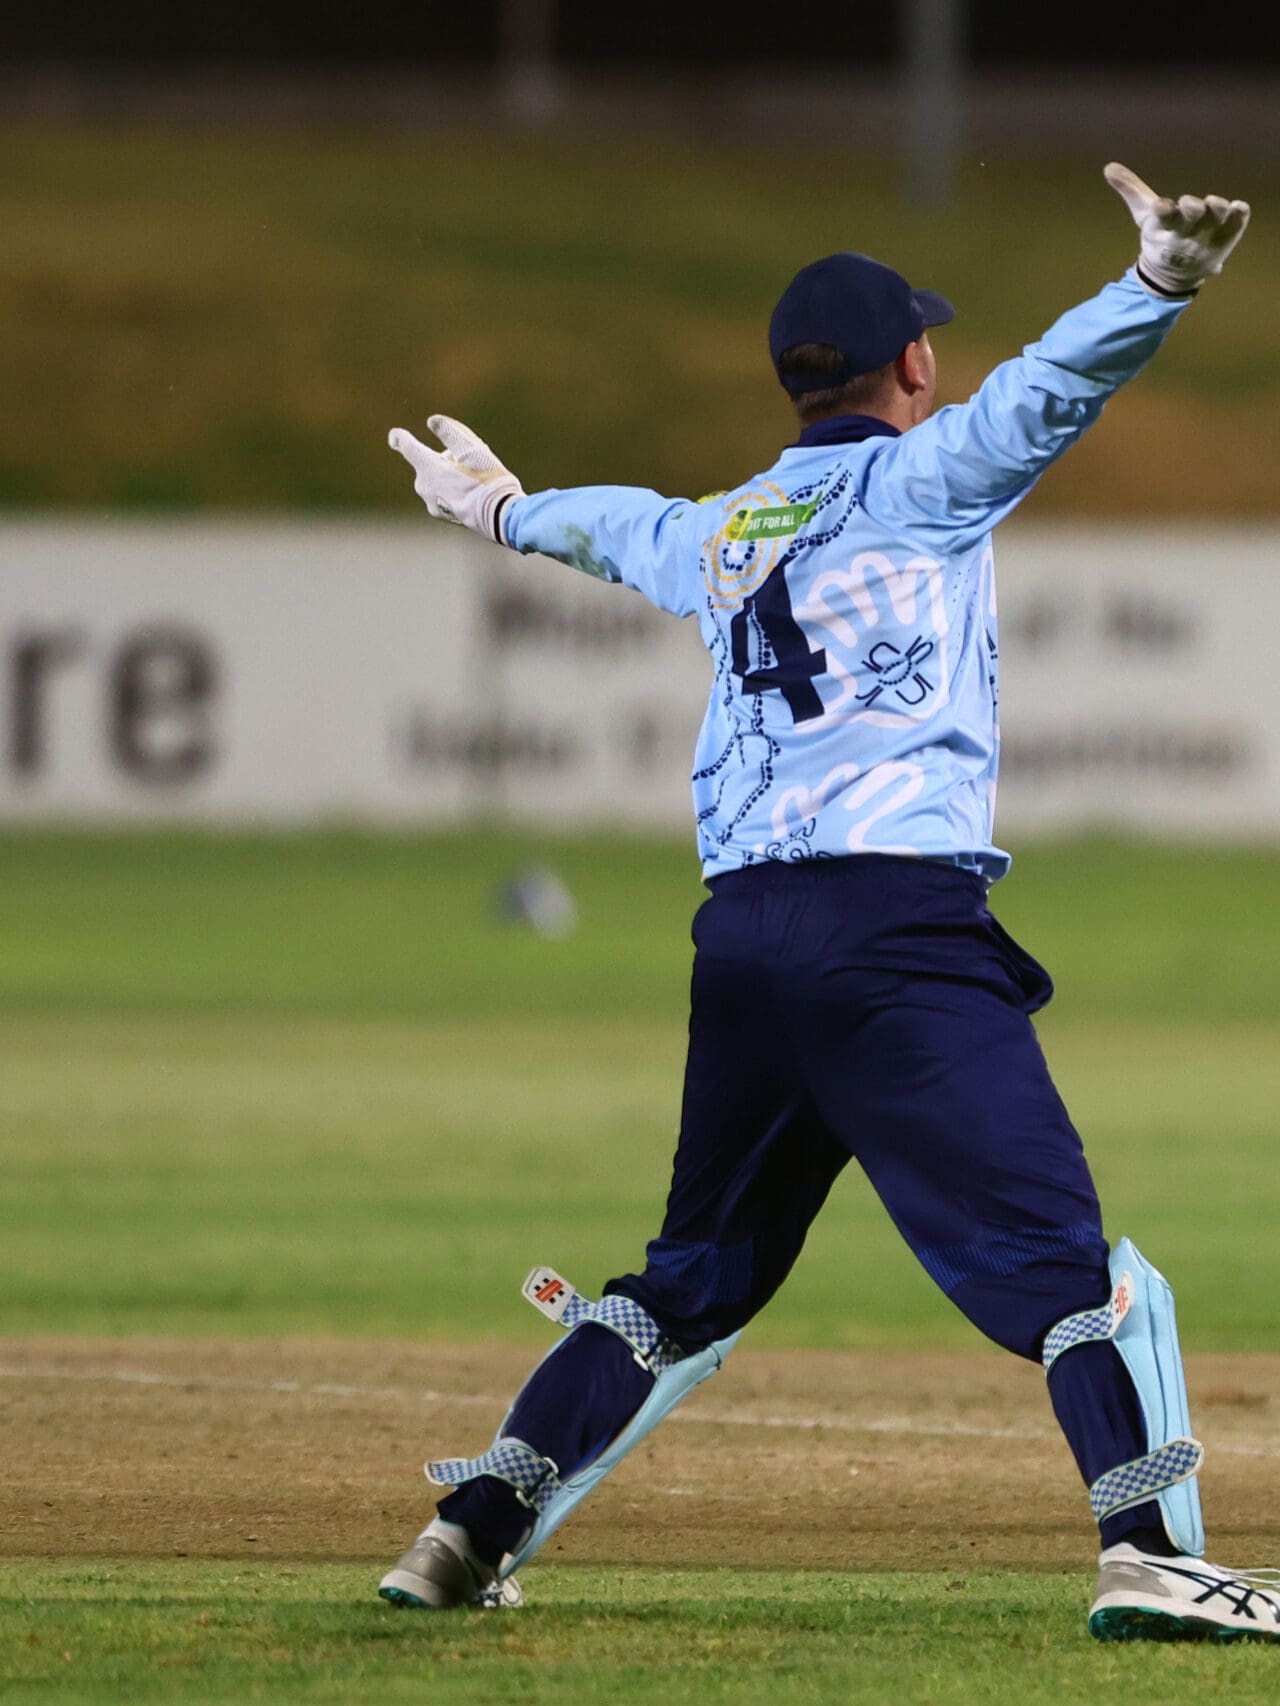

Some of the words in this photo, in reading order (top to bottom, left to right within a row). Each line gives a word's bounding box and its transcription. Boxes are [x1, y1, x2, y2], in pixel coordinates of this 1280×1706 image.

[762, 516, 781, 529] FOR
[781, 513, 795, 527] ALL
[731, 555, 828, 724] 4
